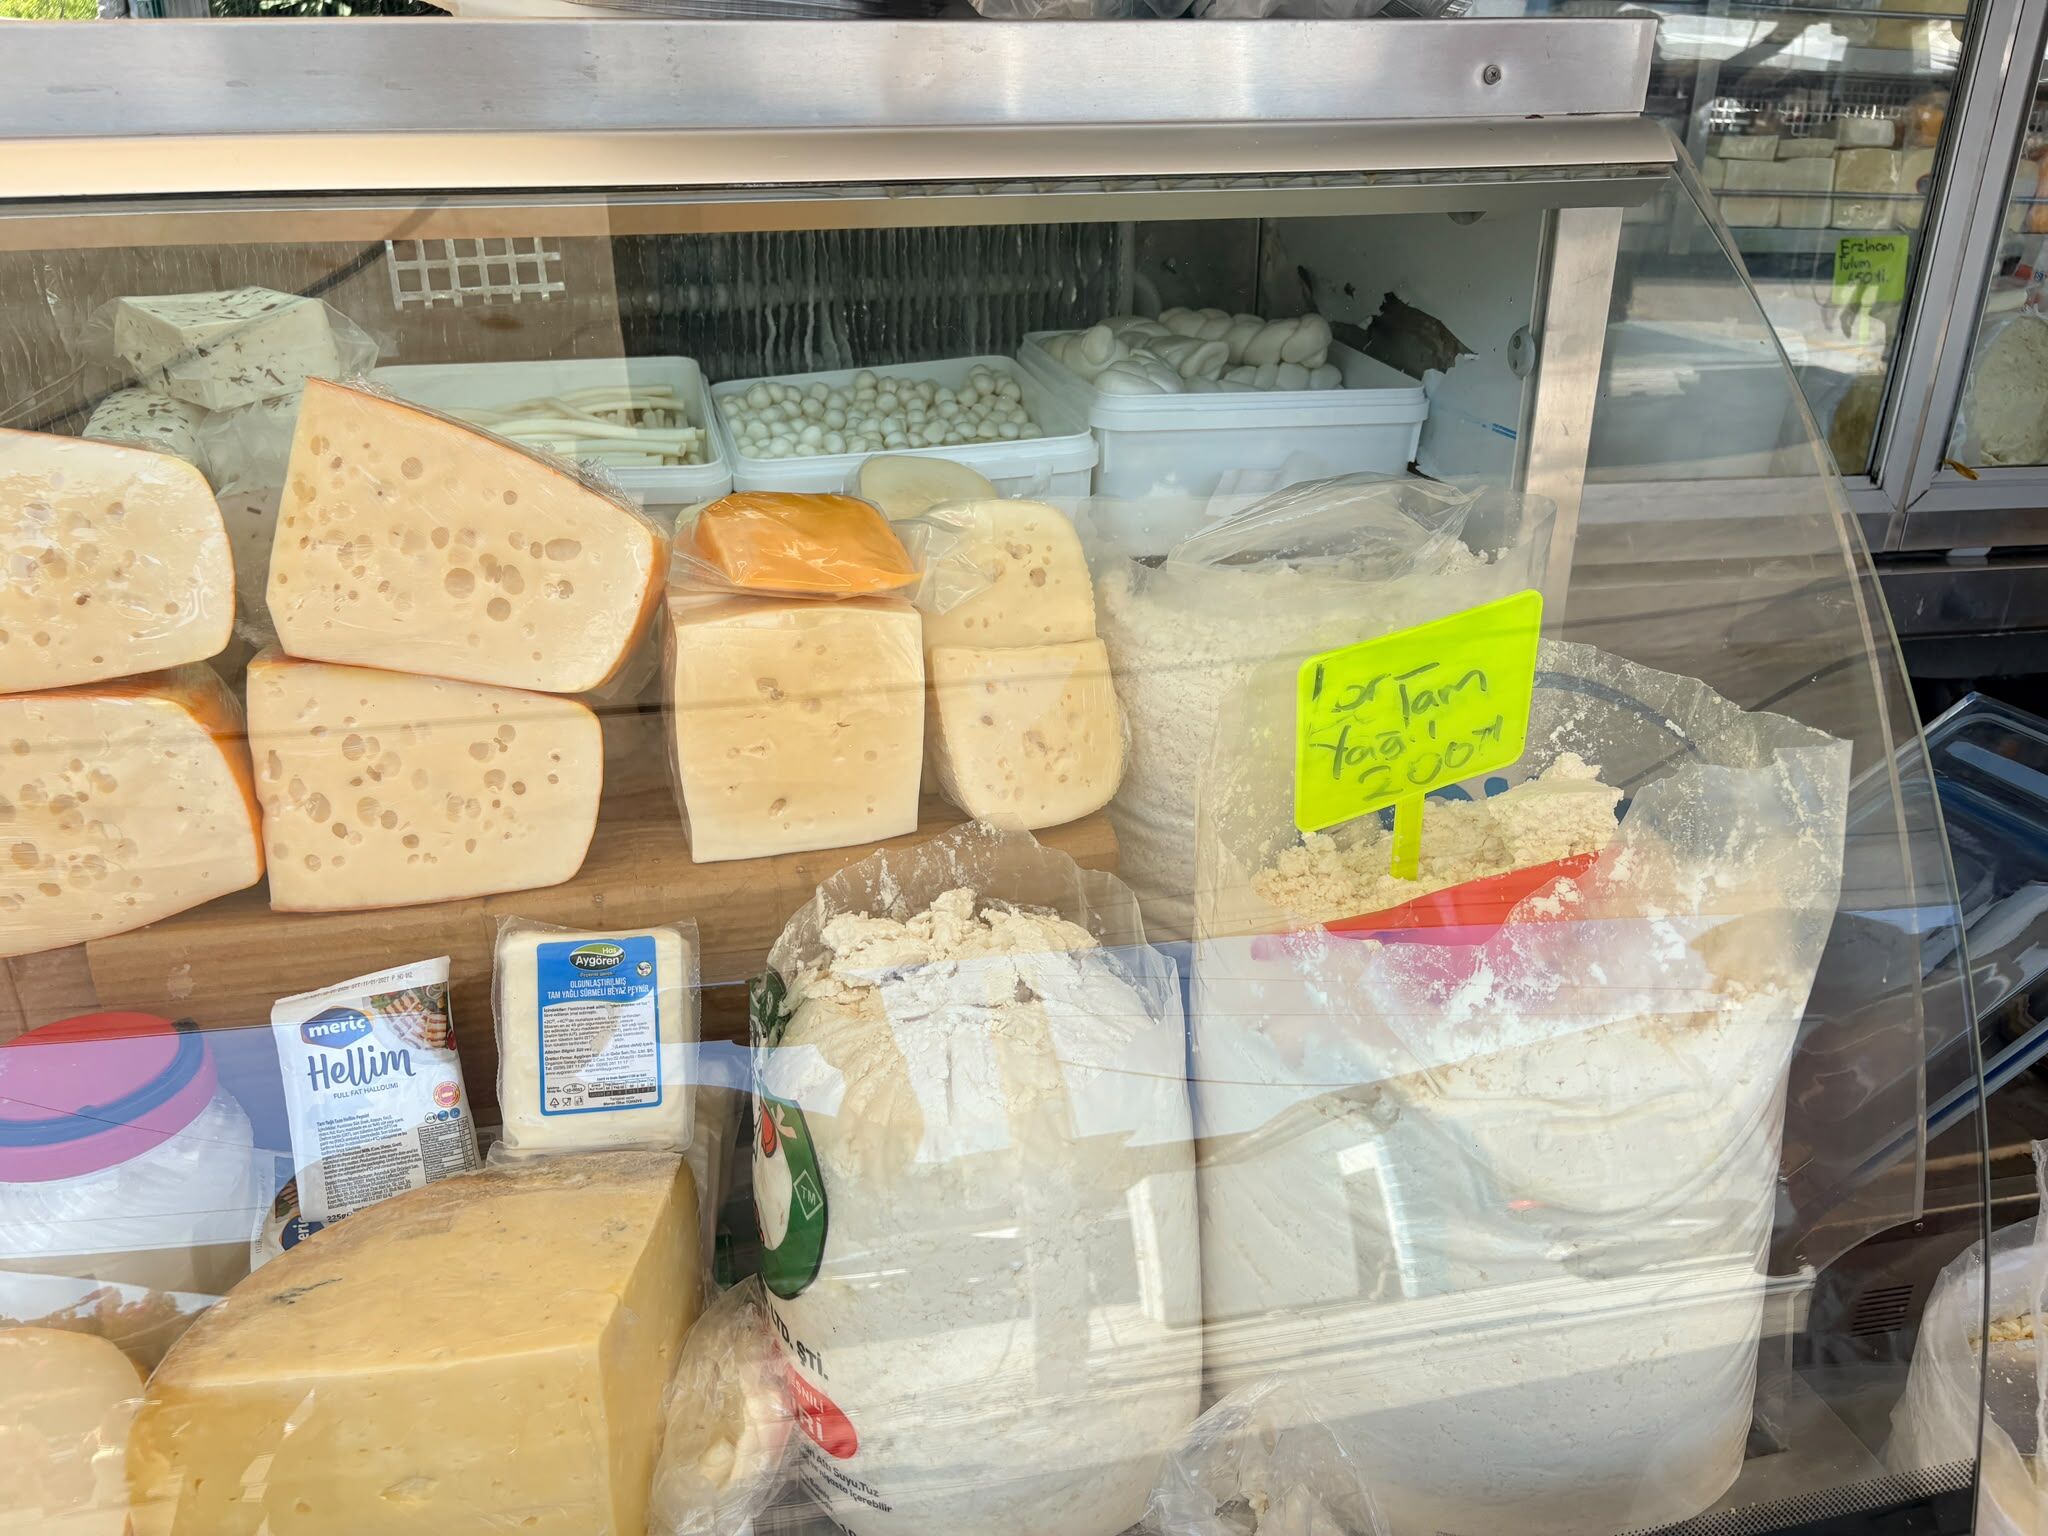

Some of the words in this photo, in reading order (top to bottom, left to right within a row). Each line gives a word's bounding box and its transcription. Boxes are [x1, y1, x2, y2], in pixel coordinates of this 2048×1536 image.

[1393, 661, 1488, 729] Tam
[1358, 741, 1475, 801] 200
[575, 955, 620, 967] Aygören
[548, 991, 560, 999] TAM
[561, 989, 579, 999] YAĞLI
[607, 985, 626, 995] BEYAZ
[308, 1015, 366, 1038] meriç
[307, 1045, 416, 1091] Hellim
[333, 1090, 349, 1099] FULL
[350, 1088, 363, 1097] FAT
[800, 1184, 816, 1205] TM
[796, 1340, 829, 1380] ŞTİ.
